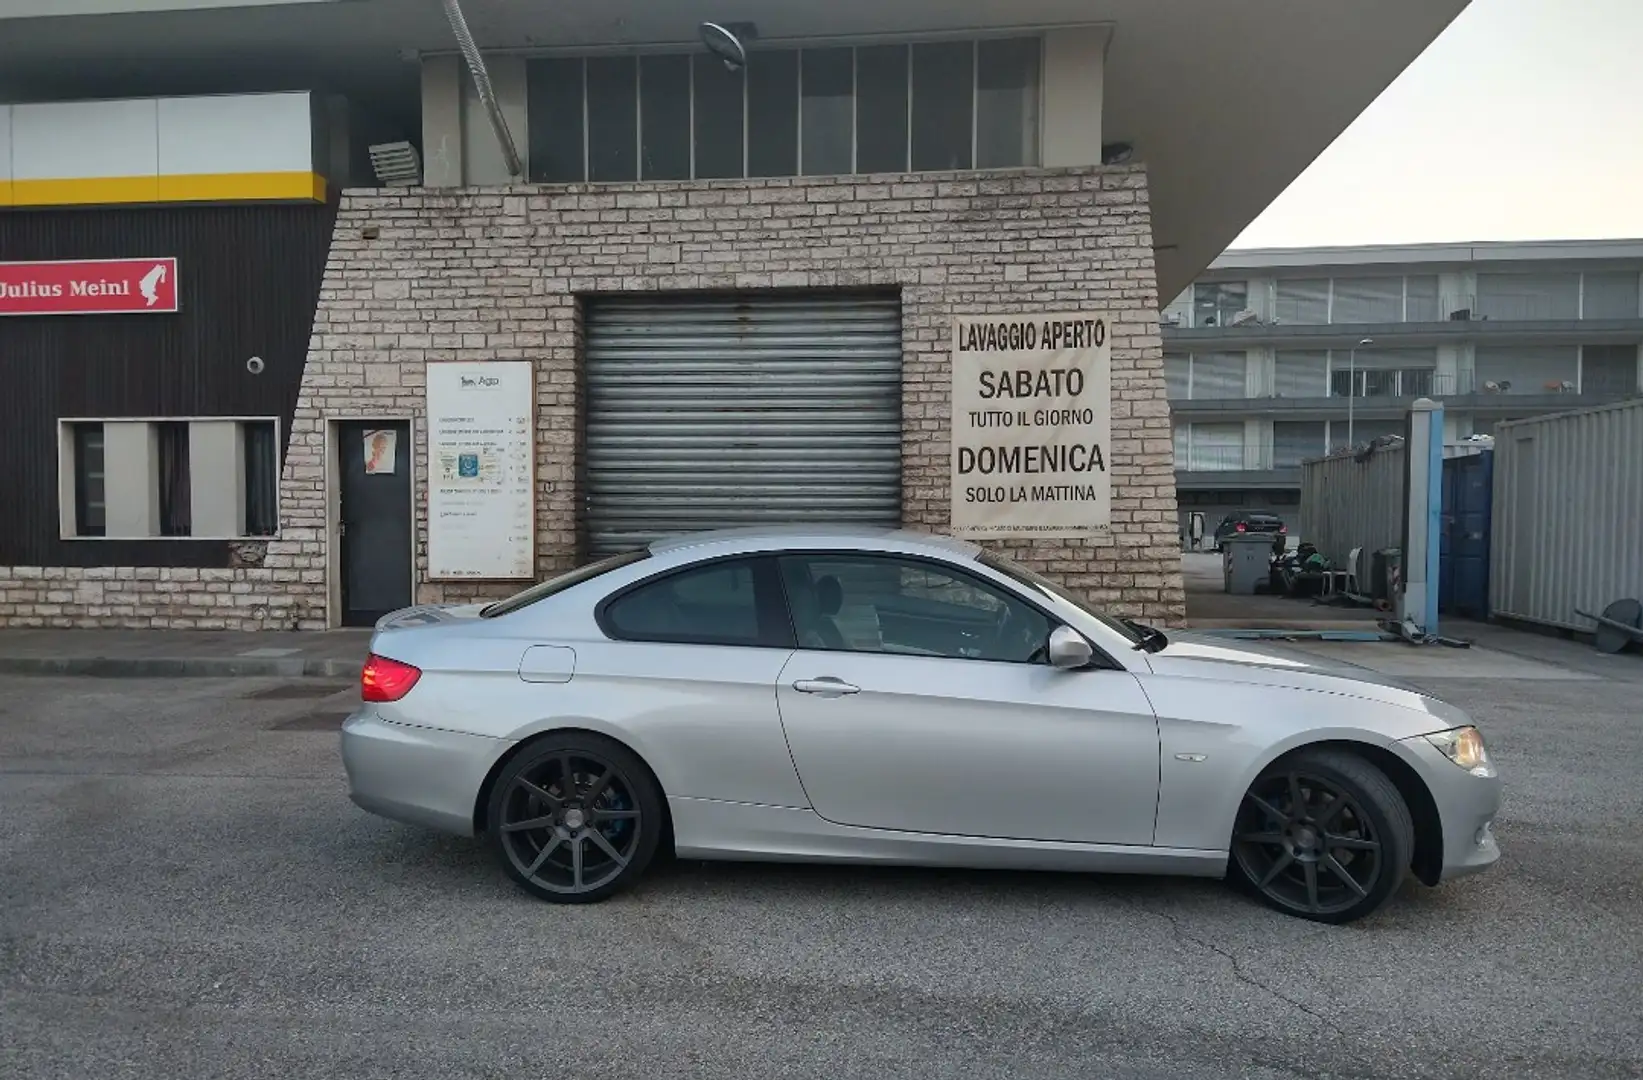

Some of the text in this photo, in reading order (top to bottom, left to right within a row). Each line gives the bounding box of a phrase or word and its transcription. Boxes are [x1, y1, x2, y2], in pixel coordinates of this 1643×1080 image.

[0, 279, 130, 298] Julius Meinl
[959, 318, 1105, 352] LAVAGGIO APERTO
[979, 368, 1084, 399] SABATO
[968, 408, 1093, 427] TUTTO IL GIORNO
[958, 443, 1105, 475] DOMENICA
[965, 485, 1096, 503] SOLO LA MATTINA
